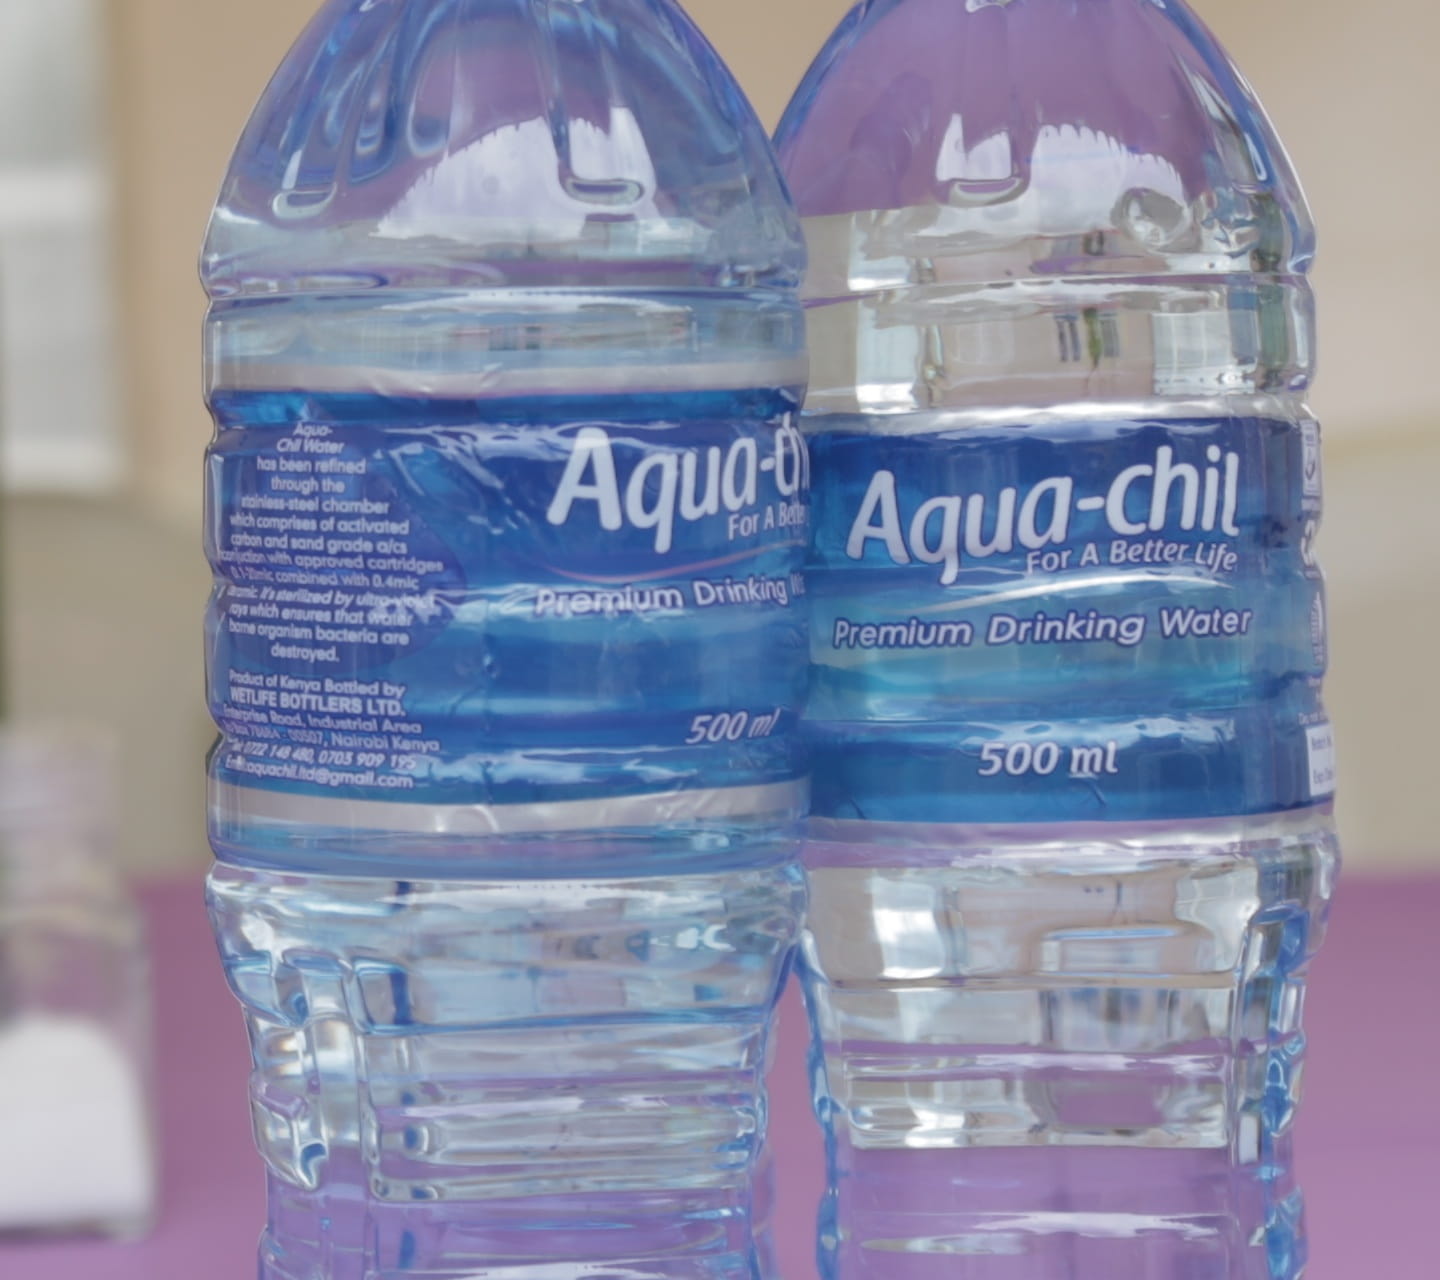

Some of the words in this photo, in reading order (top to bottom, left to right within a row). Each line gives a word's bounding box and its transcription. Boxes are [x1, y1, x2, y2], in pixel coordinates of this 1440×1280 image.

[304, 438, 344, 453] Water
[257, 456, 277, 471] has
[280, 458, 312, 472] been
[314, 458, 366, 474] refined
[271, 477, 318, 495] through
[322, 479, 345, 493] the
[322, 498, 389, 514] chamber
[846, 445, 1240, 585] Aqua-chil
[230, 513, 254, 528] which
[256, 514, 317, 532] comprises
[320, 517, 335, 531] of
[337, 518, 410, 535] activated
[728, 513, 760, 541] For
[764, 505, 775, 529] A
[264, 534, 288, 549] and
[291, 535, 324, 550] sand
[327, 537, 374, 554] grade
[268, 550, 293, 565] with
[294, 553, 364, 570] approved
[367, 556, 444, 574] cartridges
[1026, 550, 1071, 574] For
[1080, 545, 1099, 566] A
[1109, 540, 1189, 564] Better
[1195, 542, 1238, 572] Life
[276, 569, 338, 587] combined
[341, 572, 370, 587] with
[335, 592, 353, 607] by
[535, 583, 683, 615] Premium
[693, 574, 788, 605] Drinking
[250, 603, 279, 618] which
[282, 607, 332, 622] ensures
[334, 608, 364, 624] that
[257, 622, 313, 641] organism
[315, 626, 378, 643] bacteria
[381, 631, 410, 645] are
[833, 617, 971, 648] Premium
[987, 612, 1144, 645] Drinking
[1160, 607, 1252, 639] Water
[271, 643, 340, 663] destroyed.
[229, 670, 264, 687] Product
[265, 674, 278, 687] of
[280, 675, 320, 694] Kenya
[324, 678, 379, 696] Bottled
[382, 682, 406, 699] by
[230, 687, 277, 707] WETLIFE
[280, 692, 363, 714] BOTTLERS
[366, 698, 406, 717] LTD.
[308, 714, 378, 732] Industrial
[381, 720, 422, 734] Area
[685, 711, 748, 744] 500
[748, 707, 780, 738] ml
[332, 733, 390, 749] Nairobi
[392, 737, 441, 754] Kenya
[357, 751, 386, 768] 909
[978, 741, 1060, 776] 500
[1070, 741, 1118, 774] ml
